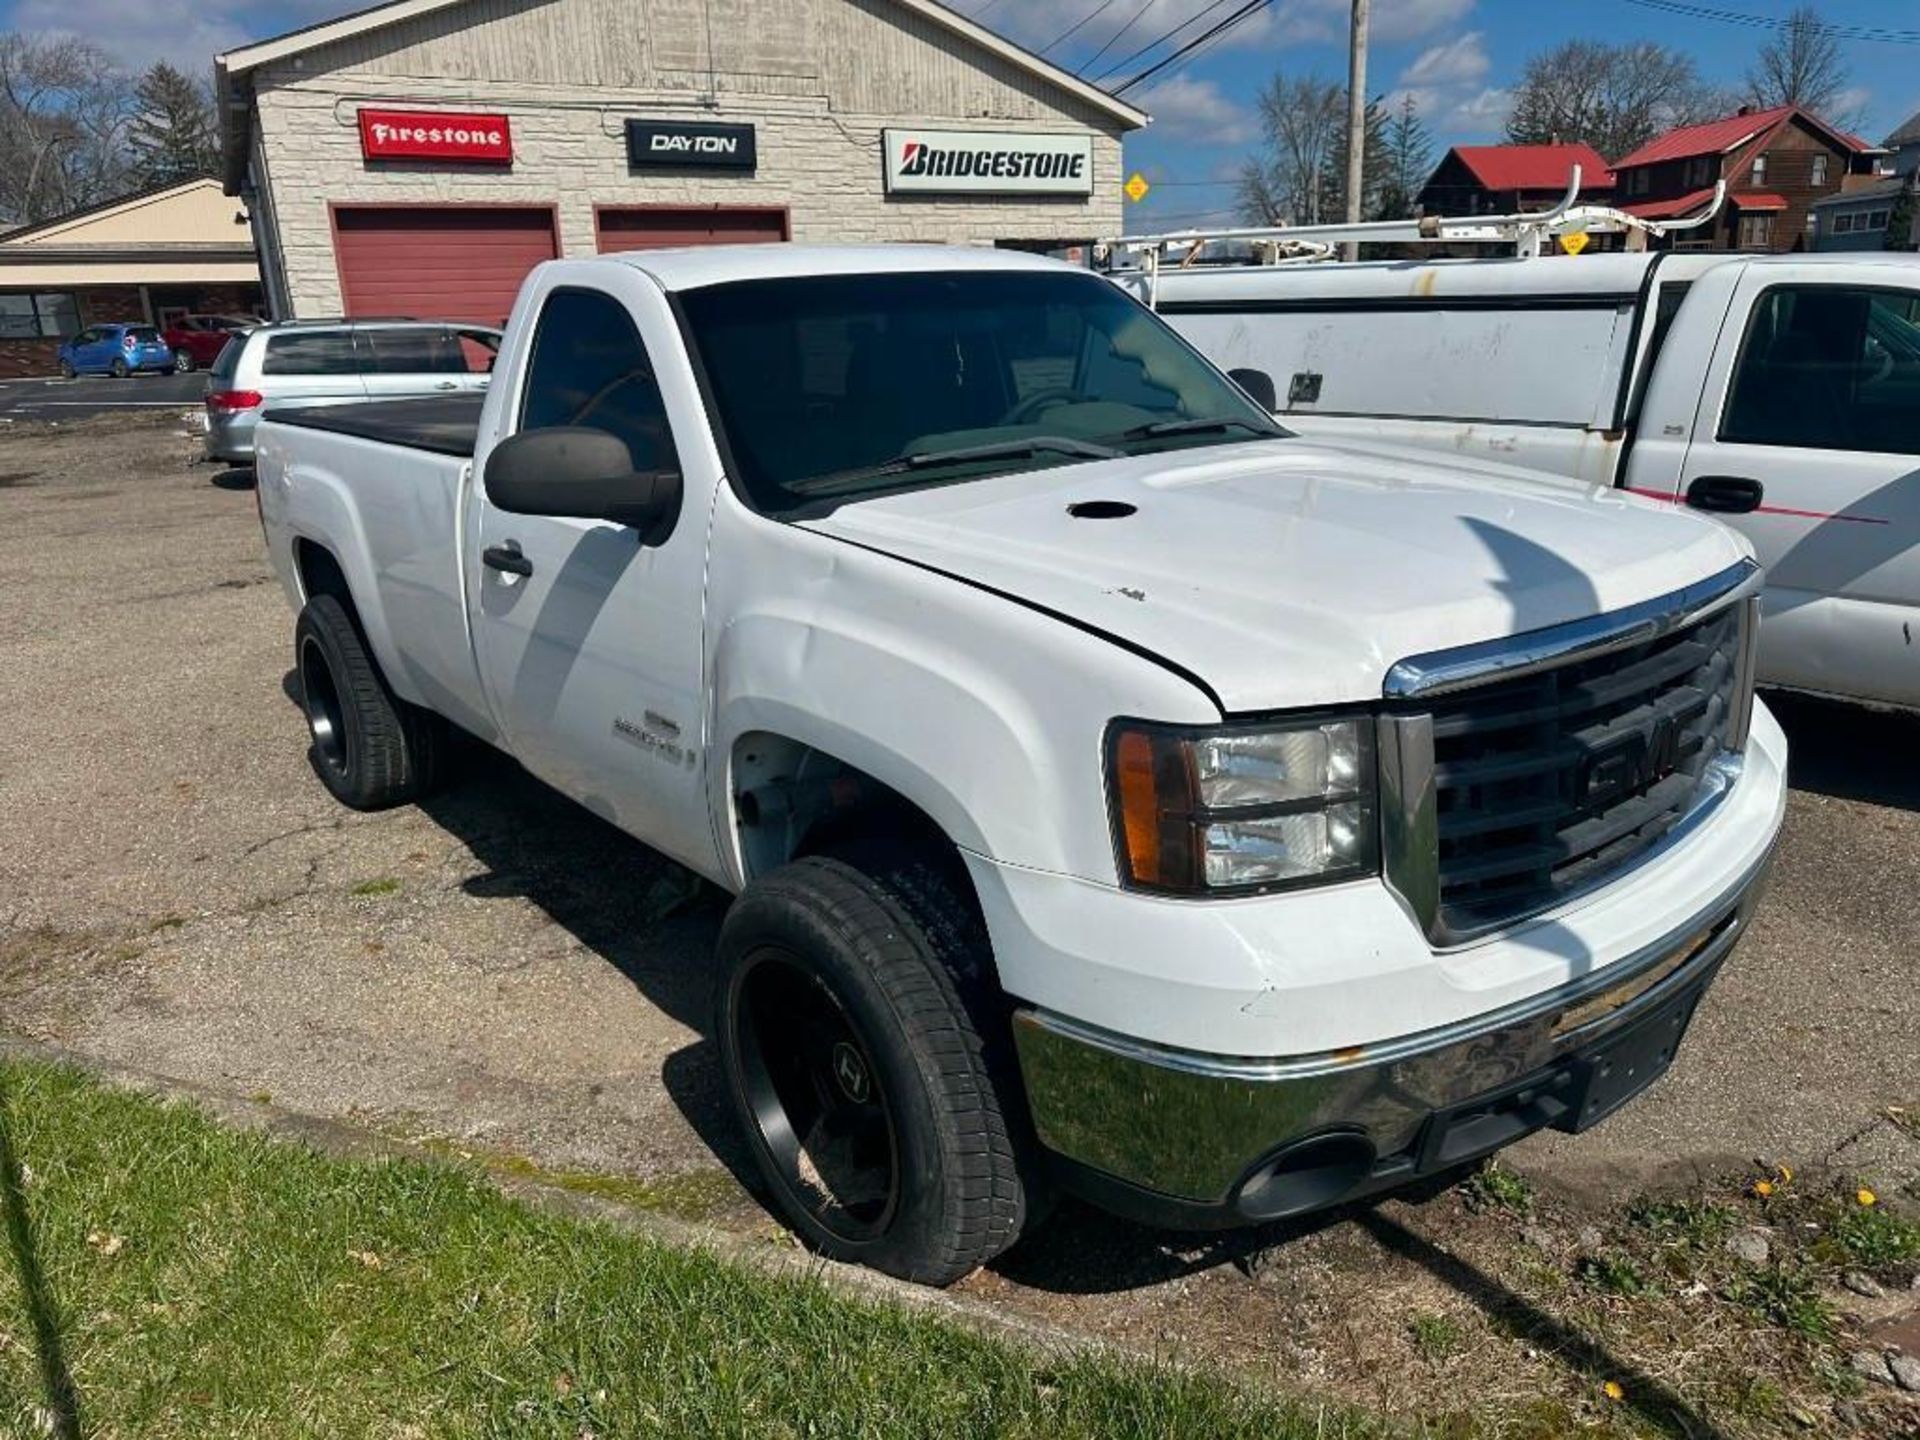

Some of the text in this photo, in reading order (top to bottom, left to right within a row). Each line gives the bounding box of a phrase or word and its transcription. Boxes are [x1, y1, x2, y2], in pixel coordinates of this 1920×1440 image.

[370, 123, 502, 145] Firestone
[650, 134, 737, 153] DAYTON
[899, 143, 1085, 179] BRIDGESTONE
